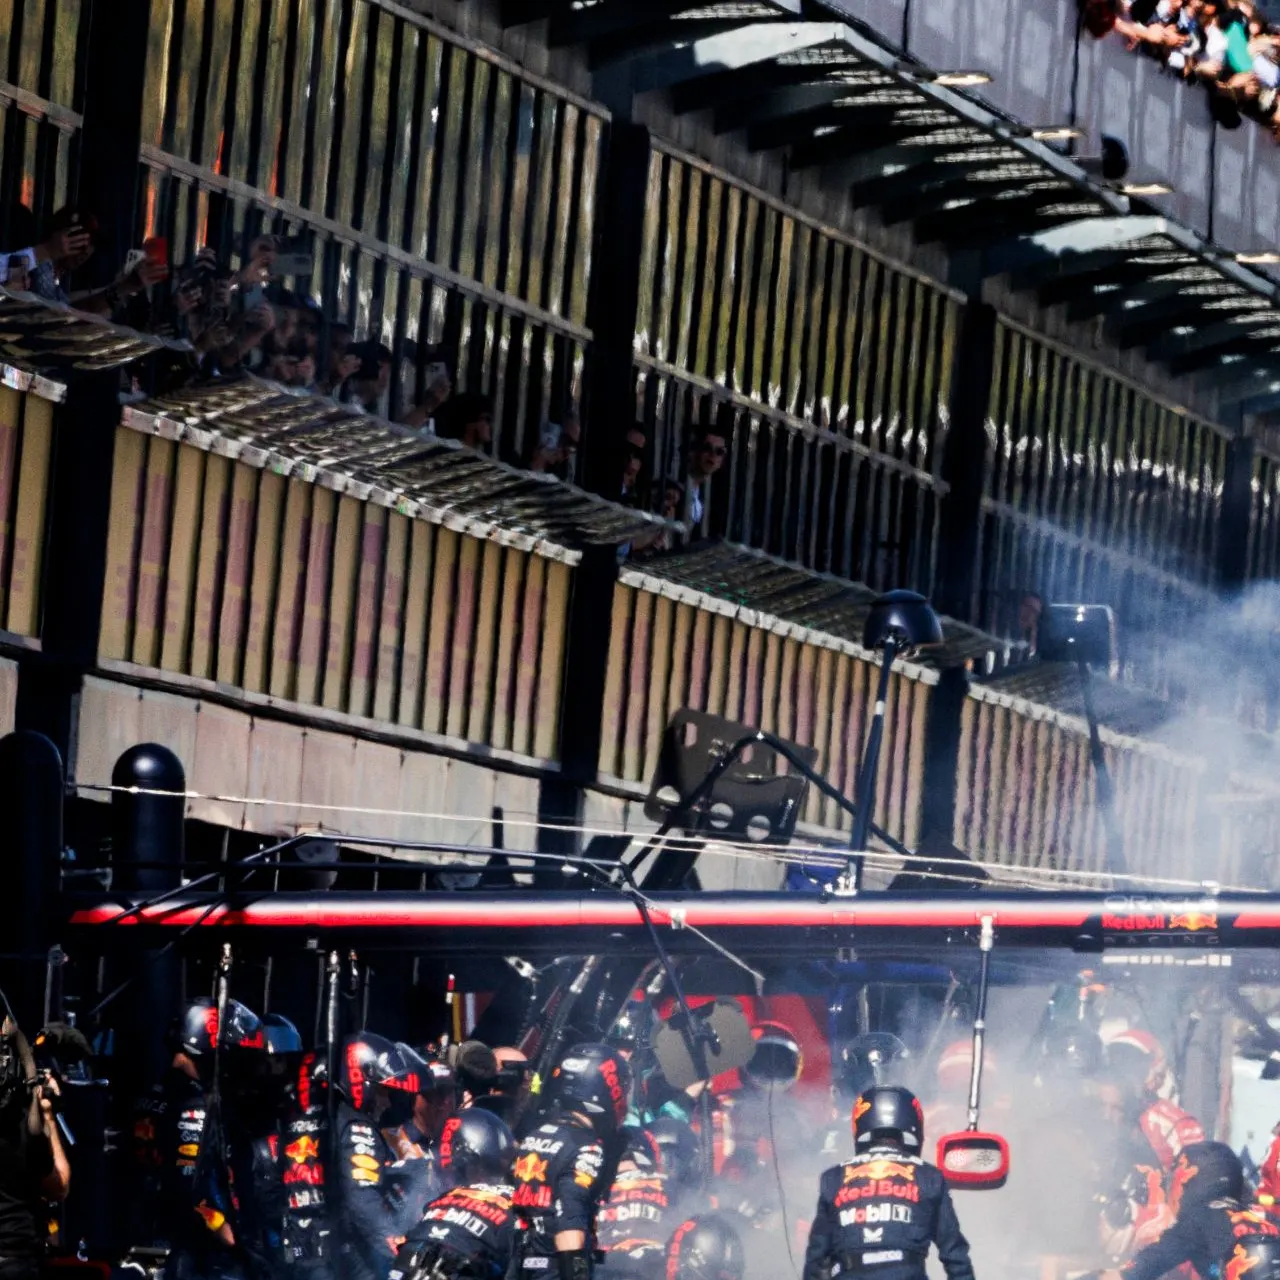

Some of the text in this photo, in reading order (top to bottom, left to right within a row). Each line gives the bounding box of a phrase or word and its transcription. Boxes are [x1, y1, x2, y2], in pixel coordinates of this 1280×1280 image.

[833, 1179, 920, 1208] Red Bull
[839, 1202, 892, 1227] Mobil
